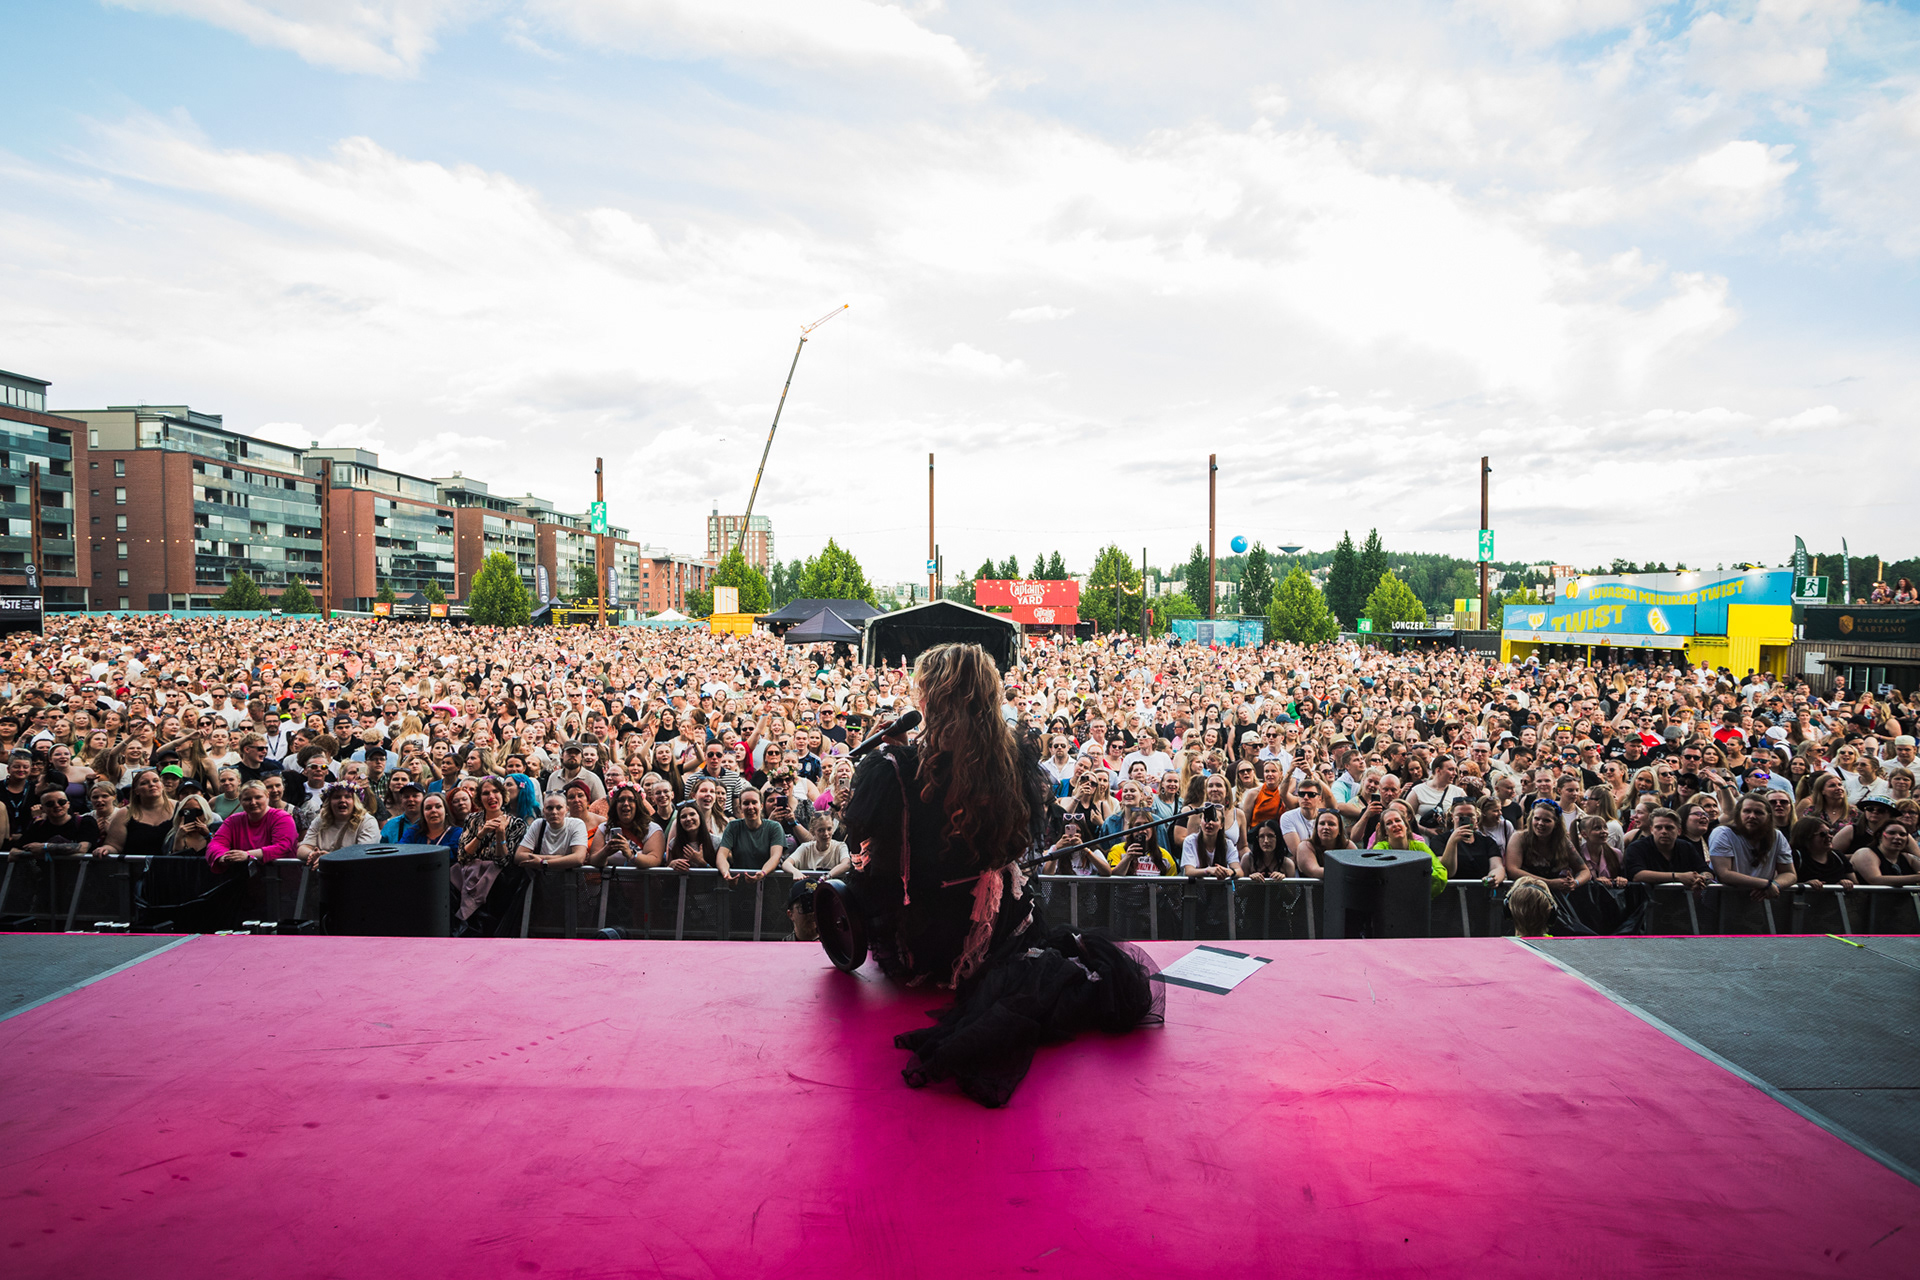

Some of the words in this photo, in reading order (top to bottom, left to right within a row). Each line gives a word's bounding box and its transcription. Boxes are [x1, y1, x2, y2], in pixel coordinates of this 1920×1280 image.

[1010, 582, 1045, 597] Captain's
[1589, 587, 1637, 601] LUVASSA
[1639, 591, 1698, 605] MEHUKAS
[1700, 580, 1745, 601] TWIST
[1016, 596, 1043, 605] YARD
[1392, 621, 1424, 630] LONGZER
[1551, 605, 1627, 632] TWIST
